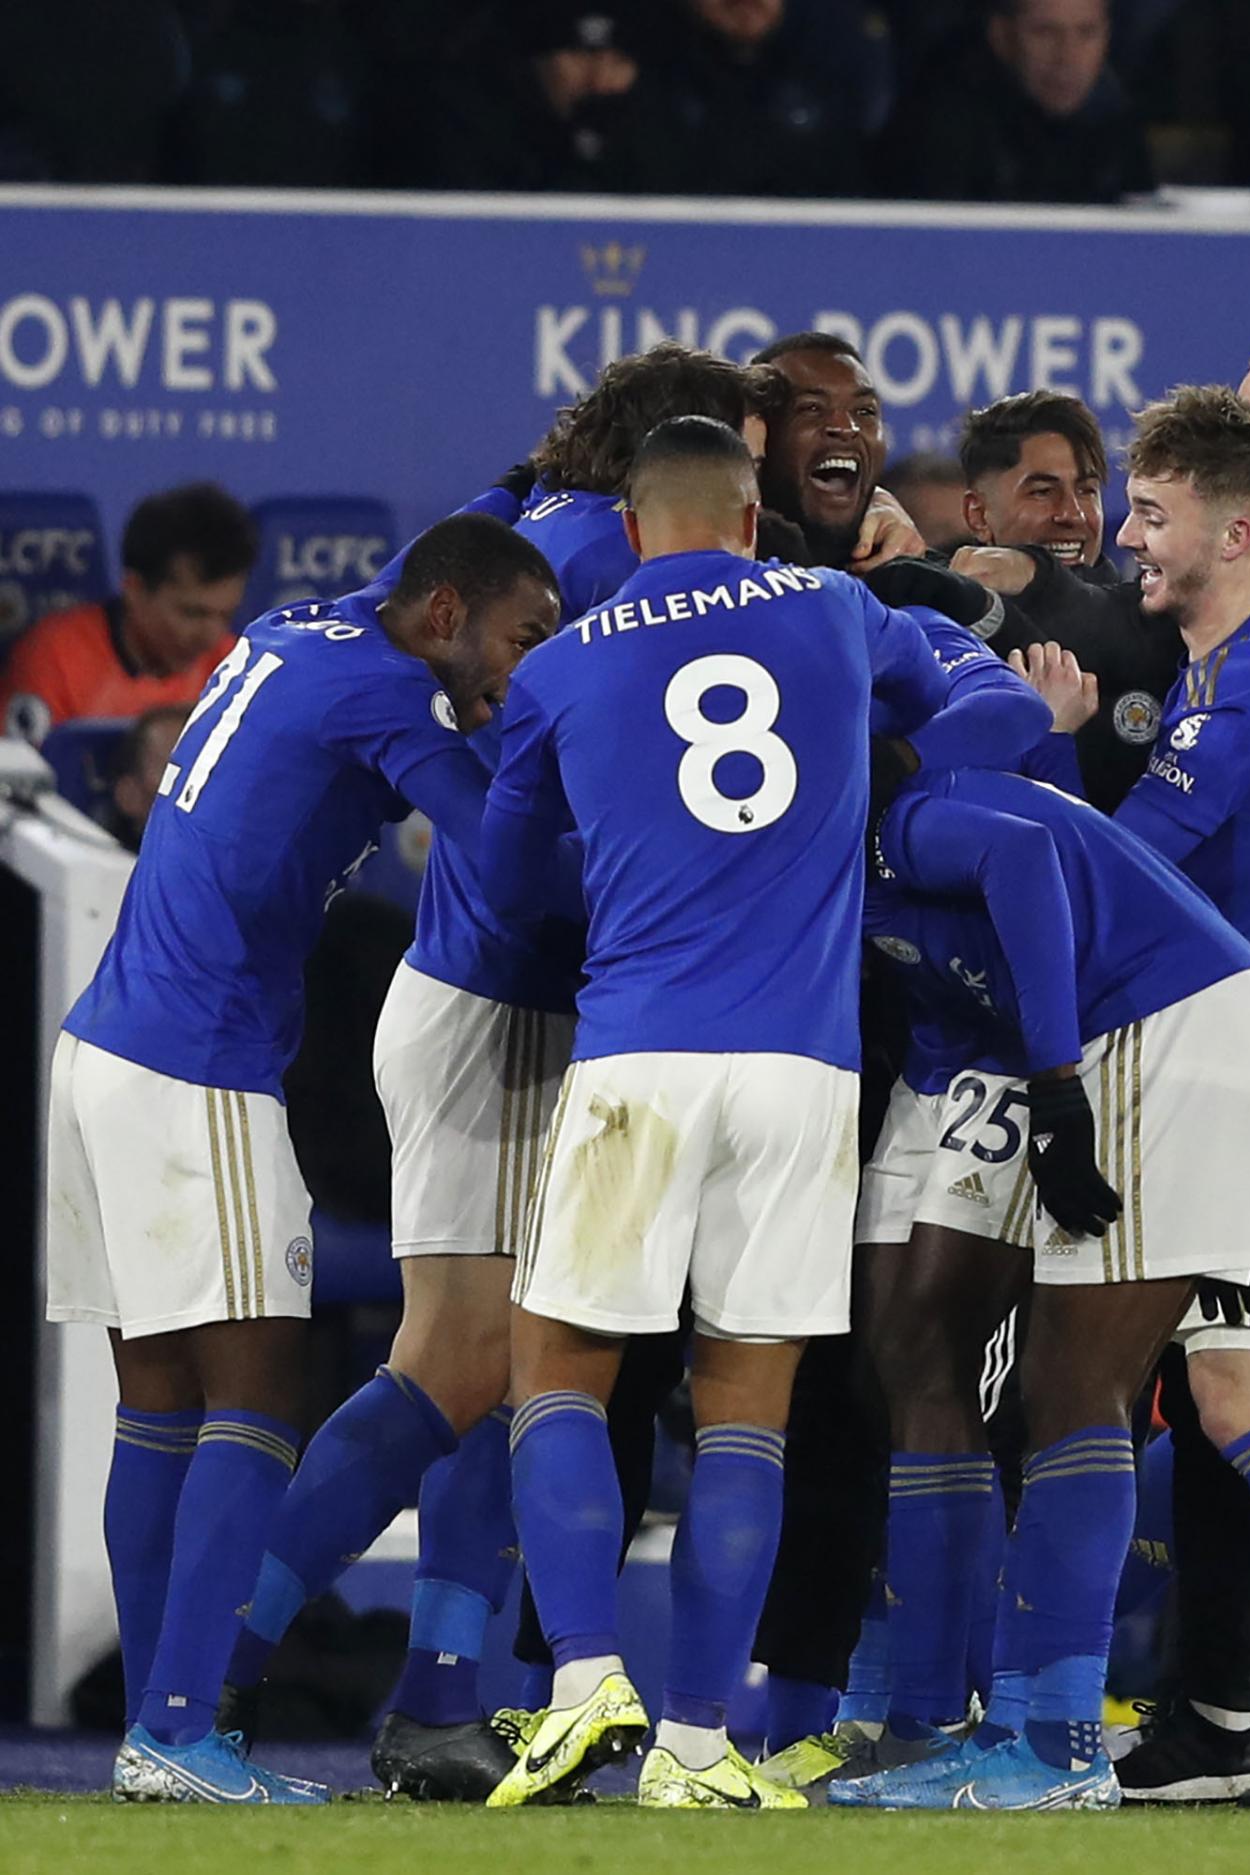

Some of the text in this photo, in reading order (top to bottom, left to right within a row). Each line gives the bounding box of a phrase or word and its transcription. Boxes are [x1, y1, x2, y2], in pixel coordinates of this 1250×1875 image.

[0, 529, 95, 575] CFC
[575, 567, 822, 644] TIELEMANS
[664, 653, 798, 834] 8
[940, 1076, 1031, 1164] 25
